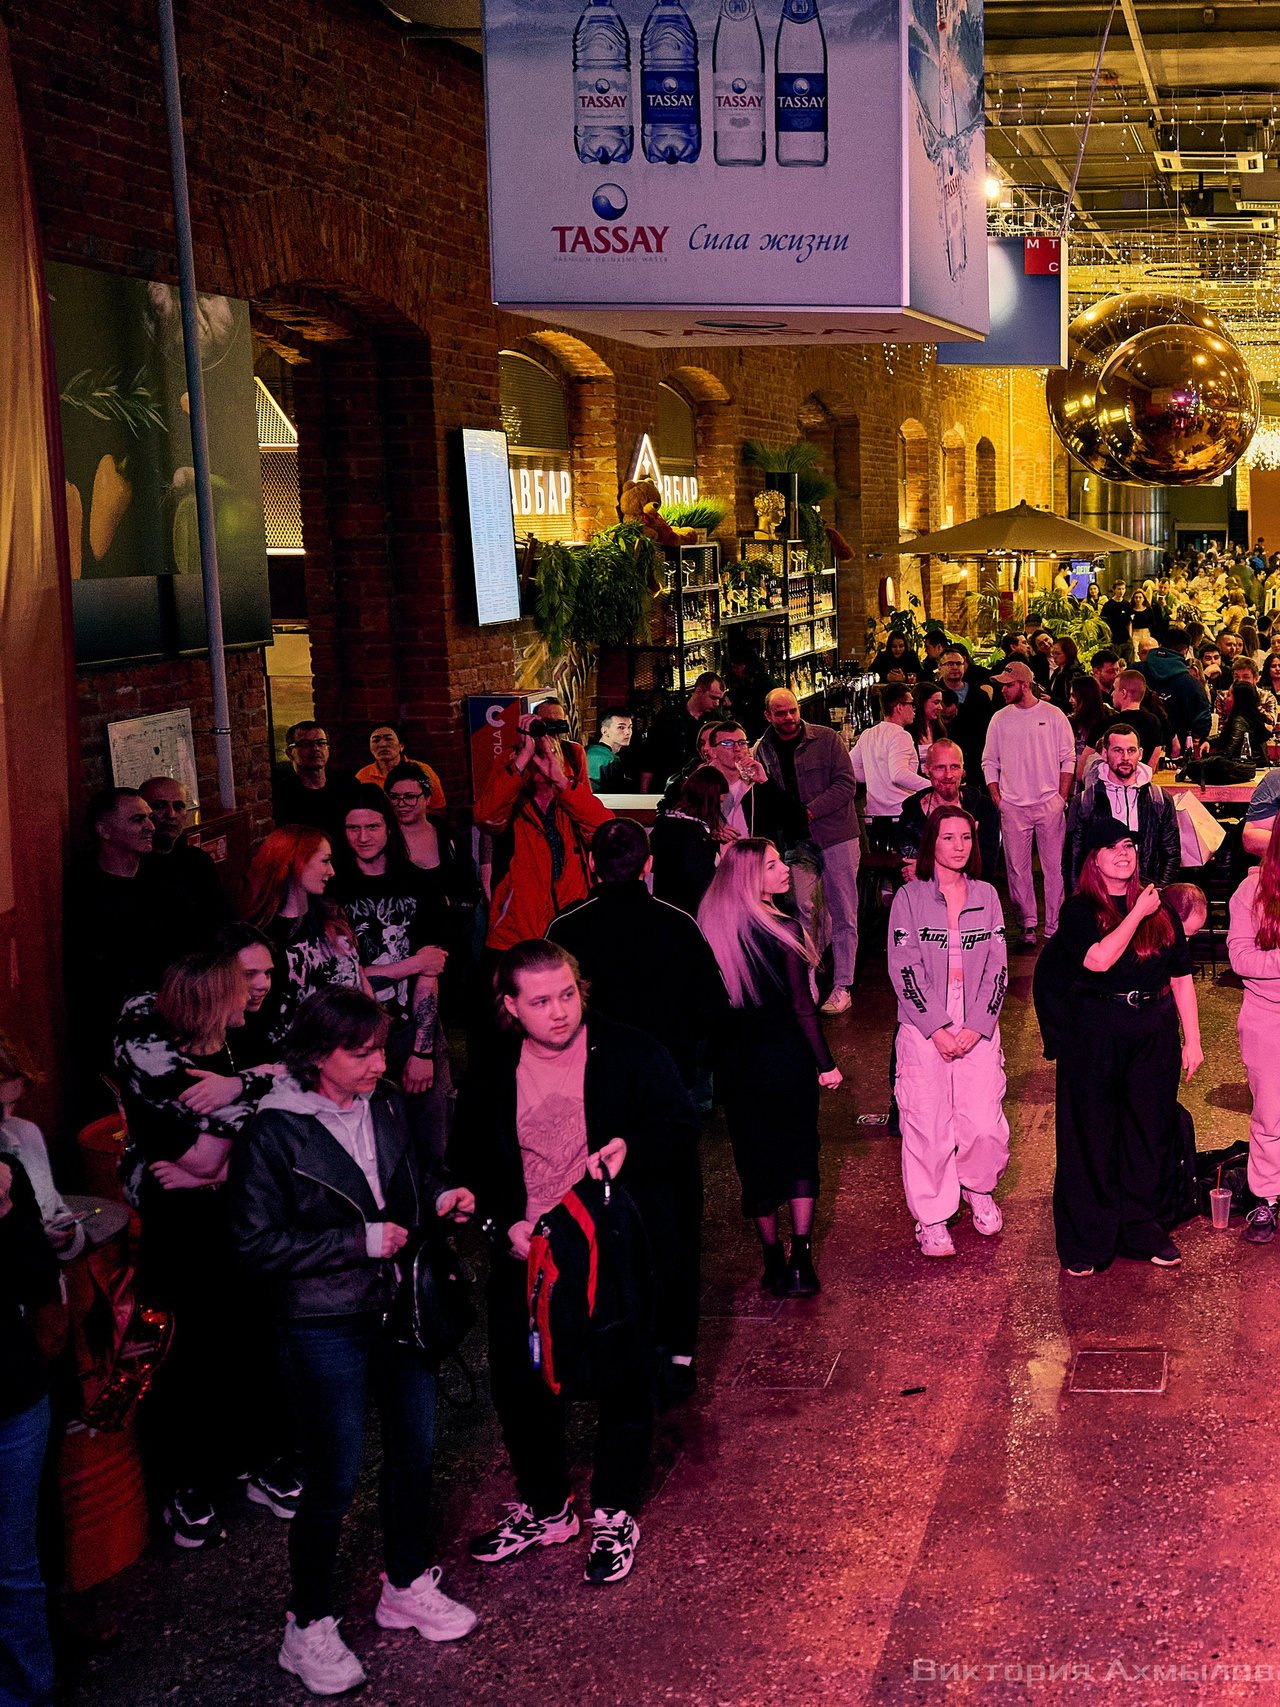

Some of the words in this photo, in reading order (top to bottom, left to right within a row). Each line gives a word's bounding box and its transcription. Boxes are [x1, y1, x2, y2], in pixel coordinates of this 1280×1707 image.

[579, 95, 628, 108] TASSAY
[646, 94, 694, 107] TASSAY
[715, 95, 764, 108] TASSAY
[777, 96, 826, 108] TASSAY
[550, 226, 670, 254] TASSAY
[689, 223, 750, 251] Сила
[759, 233, 850, 264] жизни
